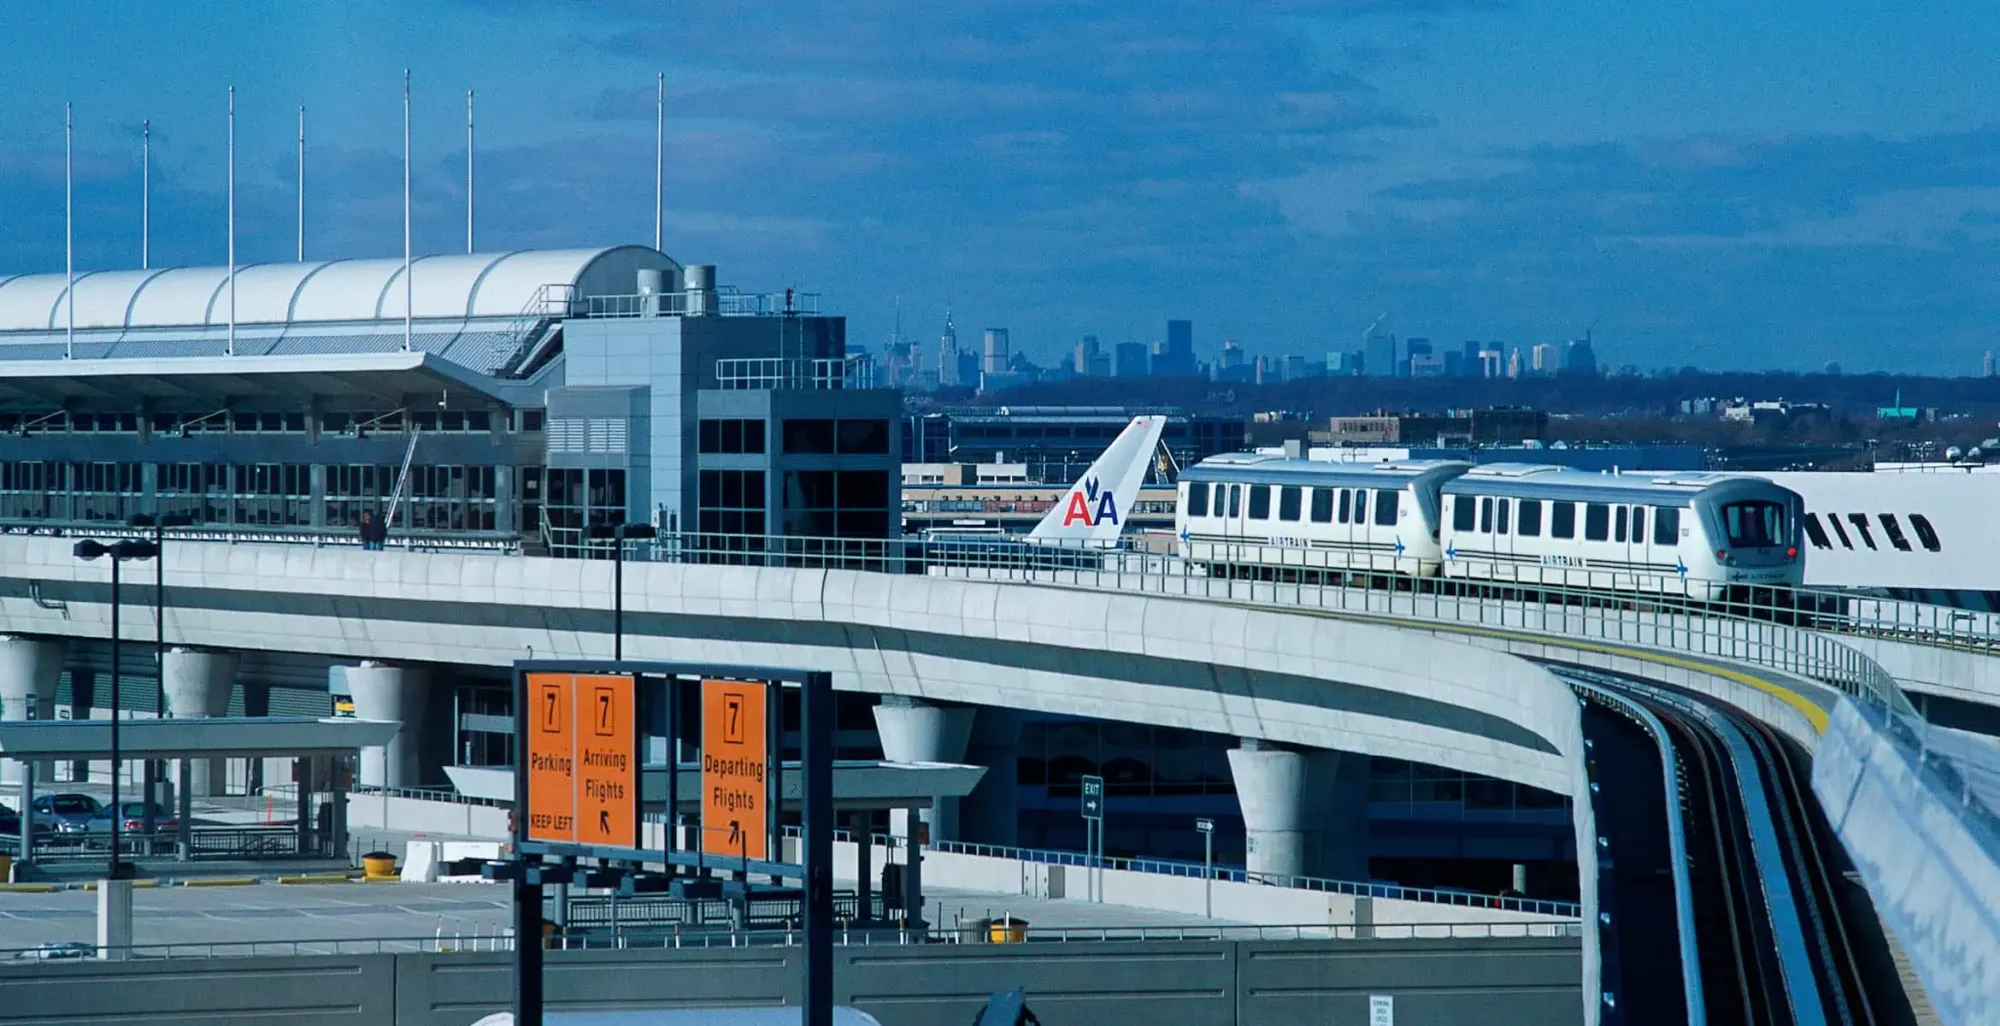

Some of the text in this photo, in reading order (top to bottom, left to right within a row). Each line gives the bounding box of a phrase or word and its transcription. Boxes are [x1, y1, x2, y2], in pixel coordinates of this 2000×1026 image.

[1063, 491, 1119, 526] AA
[1270, 536, 1309, 548] AIRTRAIN
[1804, 512, 1942, 552] NITED
[1542, 554, 1584, 568] AIRTRAIN
[547, 692, 556, 726] 7
[600, 695, 609, 729] 7
[728, 702, 739, 736] 7
[532, 752, 572, 777] Parking
[583, 748, 627, 772] Arriving
[704, 754, 764, 782] Departing
[585, 778, 625, 803] Flights
[713, 786, 755, 812] Flights
[1084, 782, 1100, 796] EXIT
[530, 813, 574, 831] KEEP LEFT
